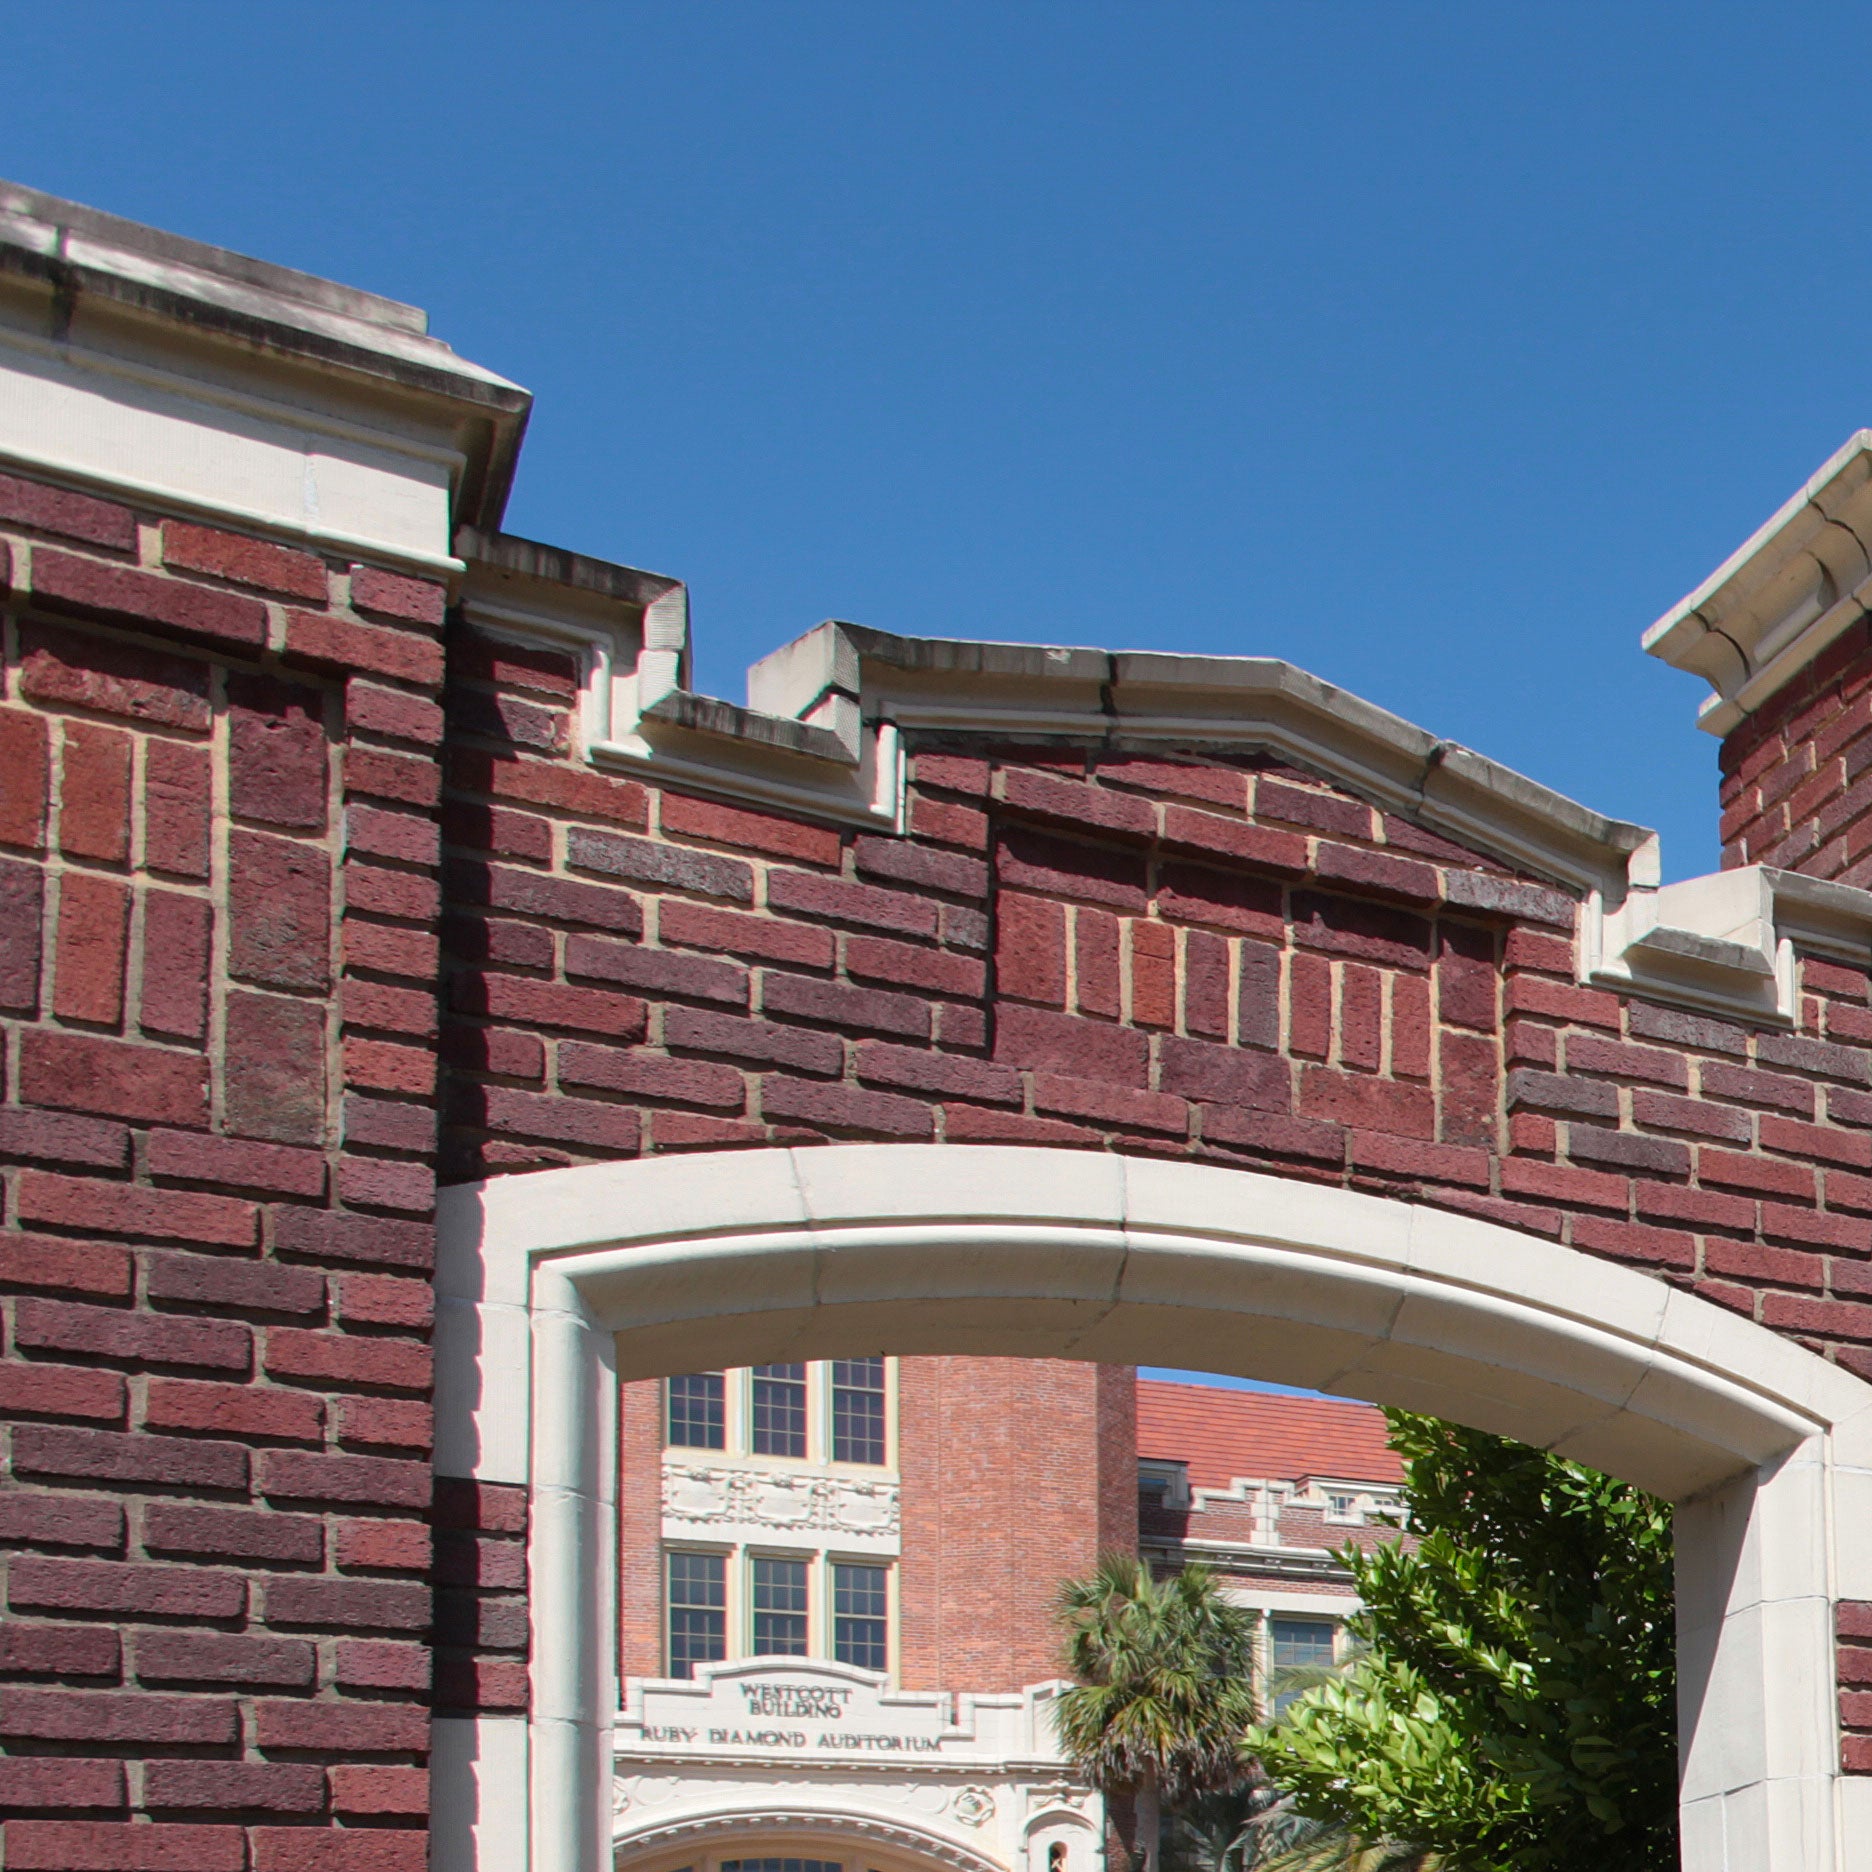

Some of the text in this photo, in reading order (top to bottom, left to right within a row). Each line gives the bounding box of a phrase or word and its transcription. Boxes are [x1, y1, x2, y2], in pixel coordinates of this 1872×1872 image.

[740, 1682, 852, 1704] WESTCOTT
[750, 1701, 842, 1719] BUILDING
[641, 1726, 943, 1752] RUBY DIAMOND AUDITORIUM
